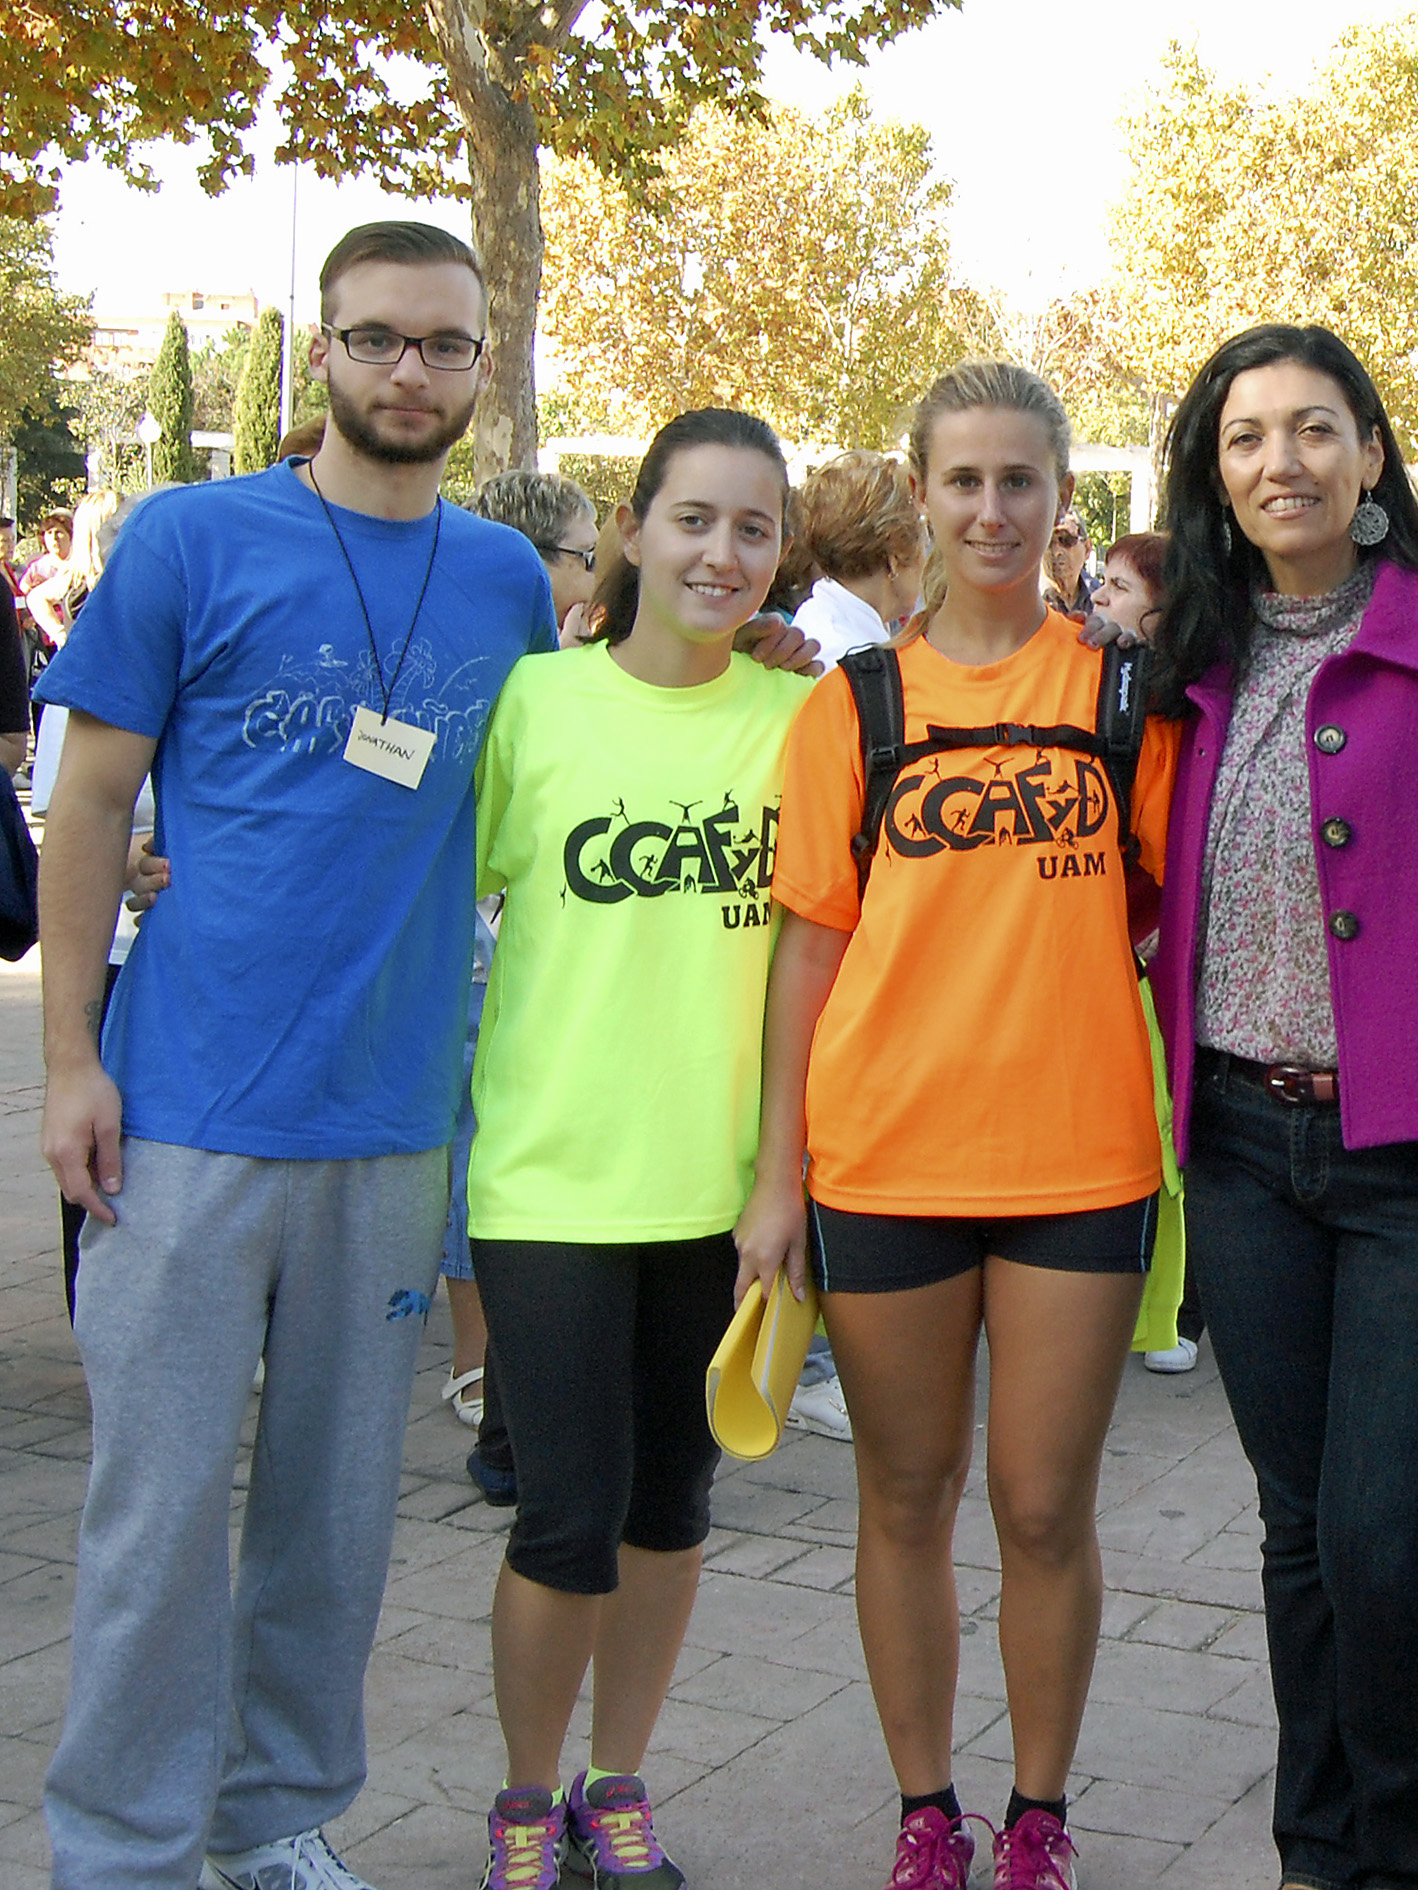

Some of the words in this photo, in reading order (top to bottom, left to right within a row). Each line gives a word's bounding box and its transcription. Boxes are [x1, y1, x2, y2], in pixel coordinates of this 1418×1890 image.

[357, 729, 416, 761] JONATHAN
[885, 759, 1108, 859] CCAFyD
[1036, 852, 1107, 879] UAM
